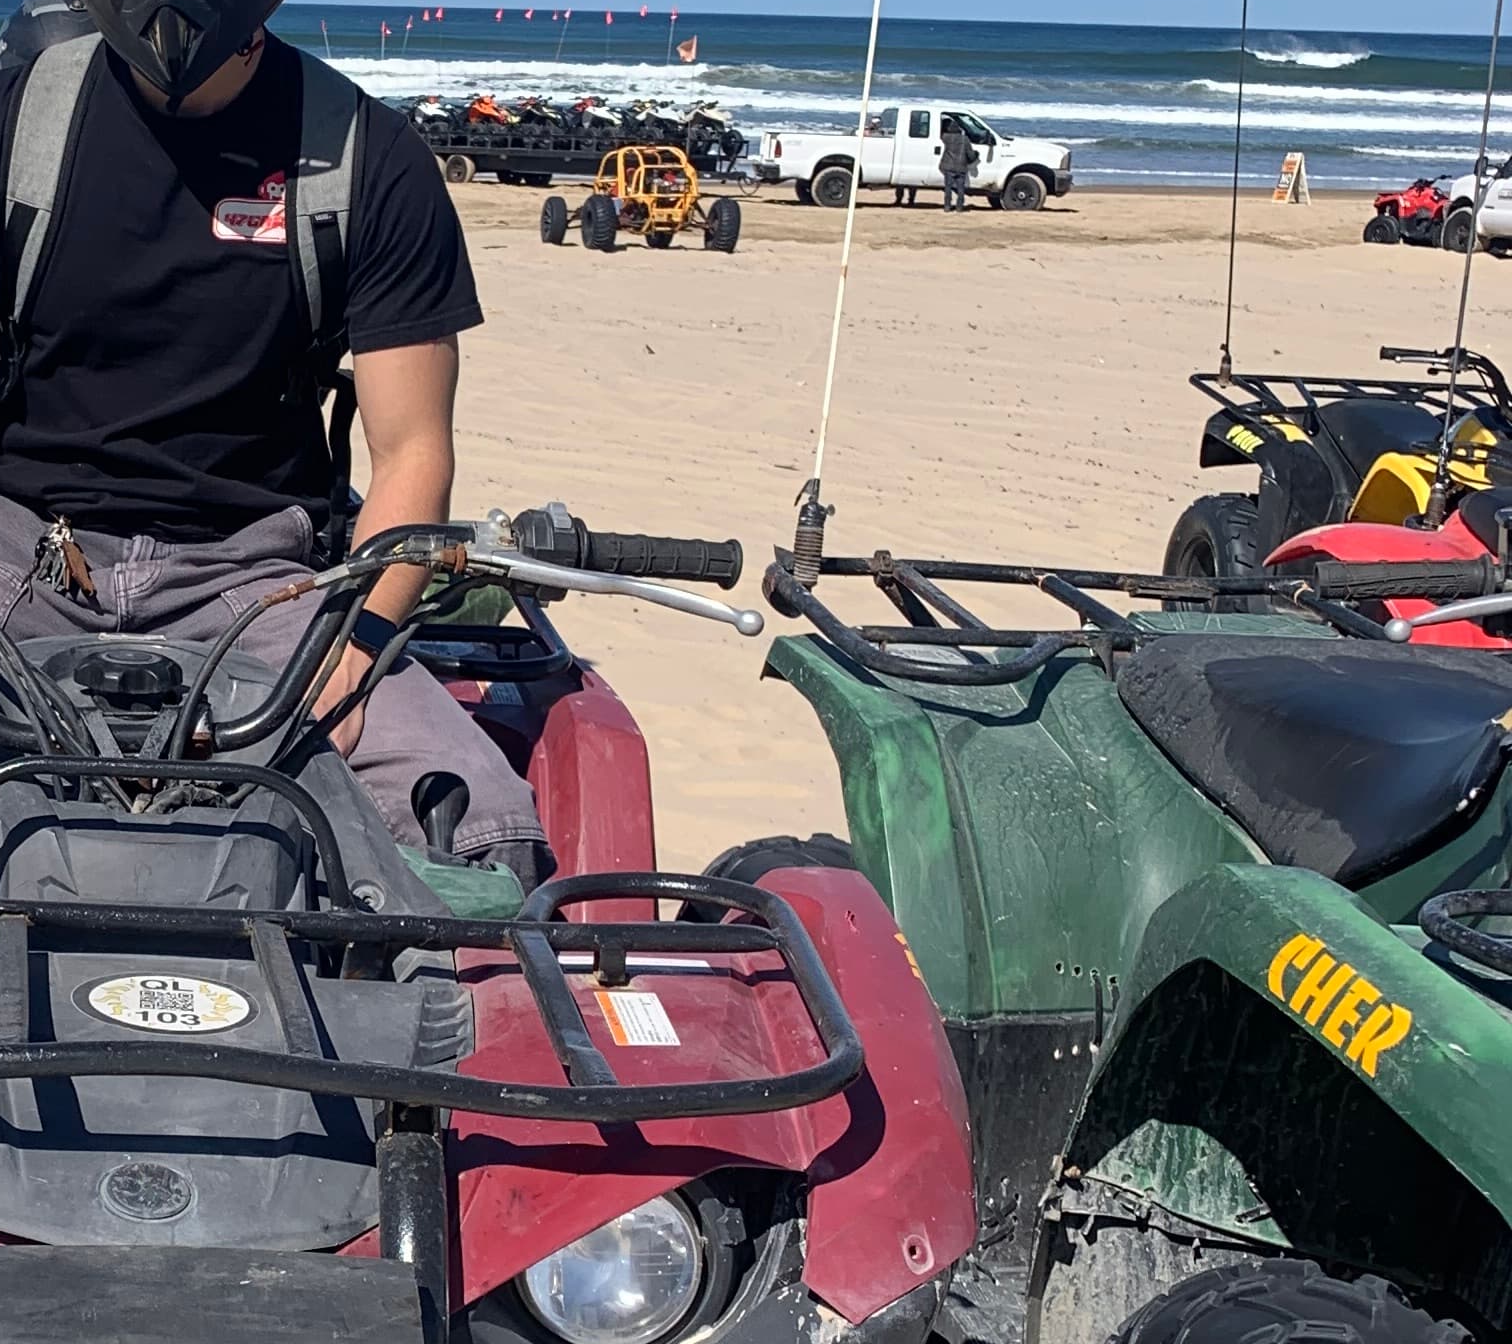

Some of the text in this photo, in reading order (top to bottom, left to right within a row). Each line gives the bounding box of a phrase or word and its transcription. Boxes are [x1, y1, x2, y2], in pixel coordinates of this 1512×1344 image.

[1226, 424, 1265, 453] PAUL
[139, 979, 193, 993] QL
[1267, 933, 1413, 1078] CHER
[135, 1010, 202, 1026] 103
